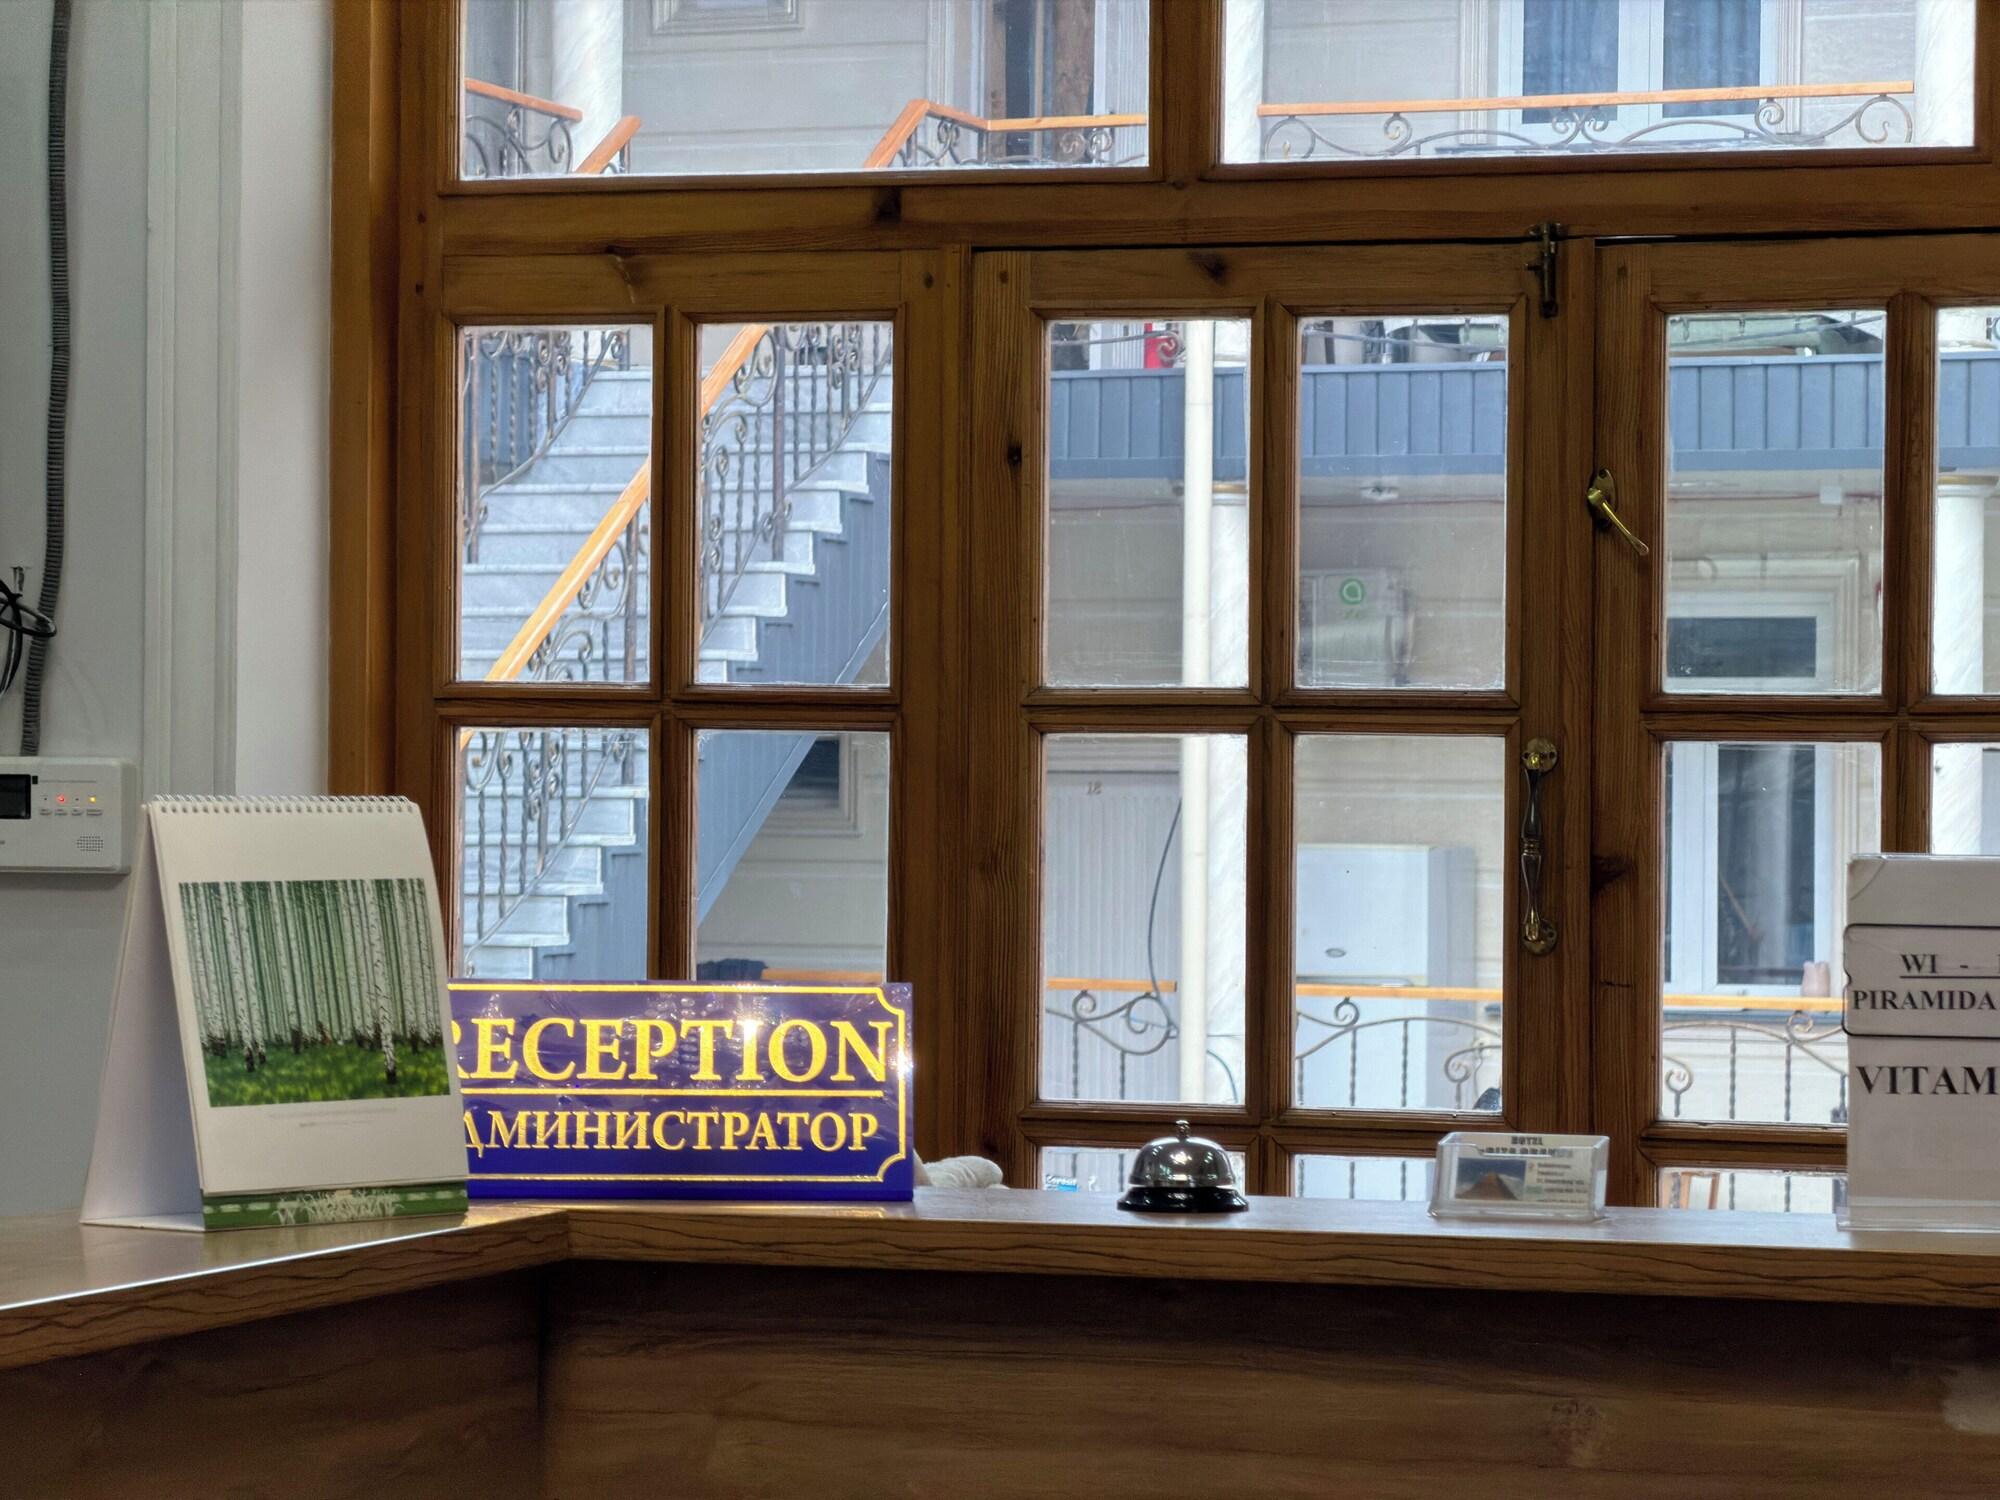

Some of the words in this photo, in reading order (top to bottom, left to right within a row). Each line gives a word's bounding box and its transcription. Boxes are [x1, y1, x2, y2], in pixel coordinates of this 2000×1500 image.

[1900, 953, 1937, 973] WI
[1853, 990, 1997, 1010] PIRAMIDA
[1856, 1065, 1999, 1095] VITAM
